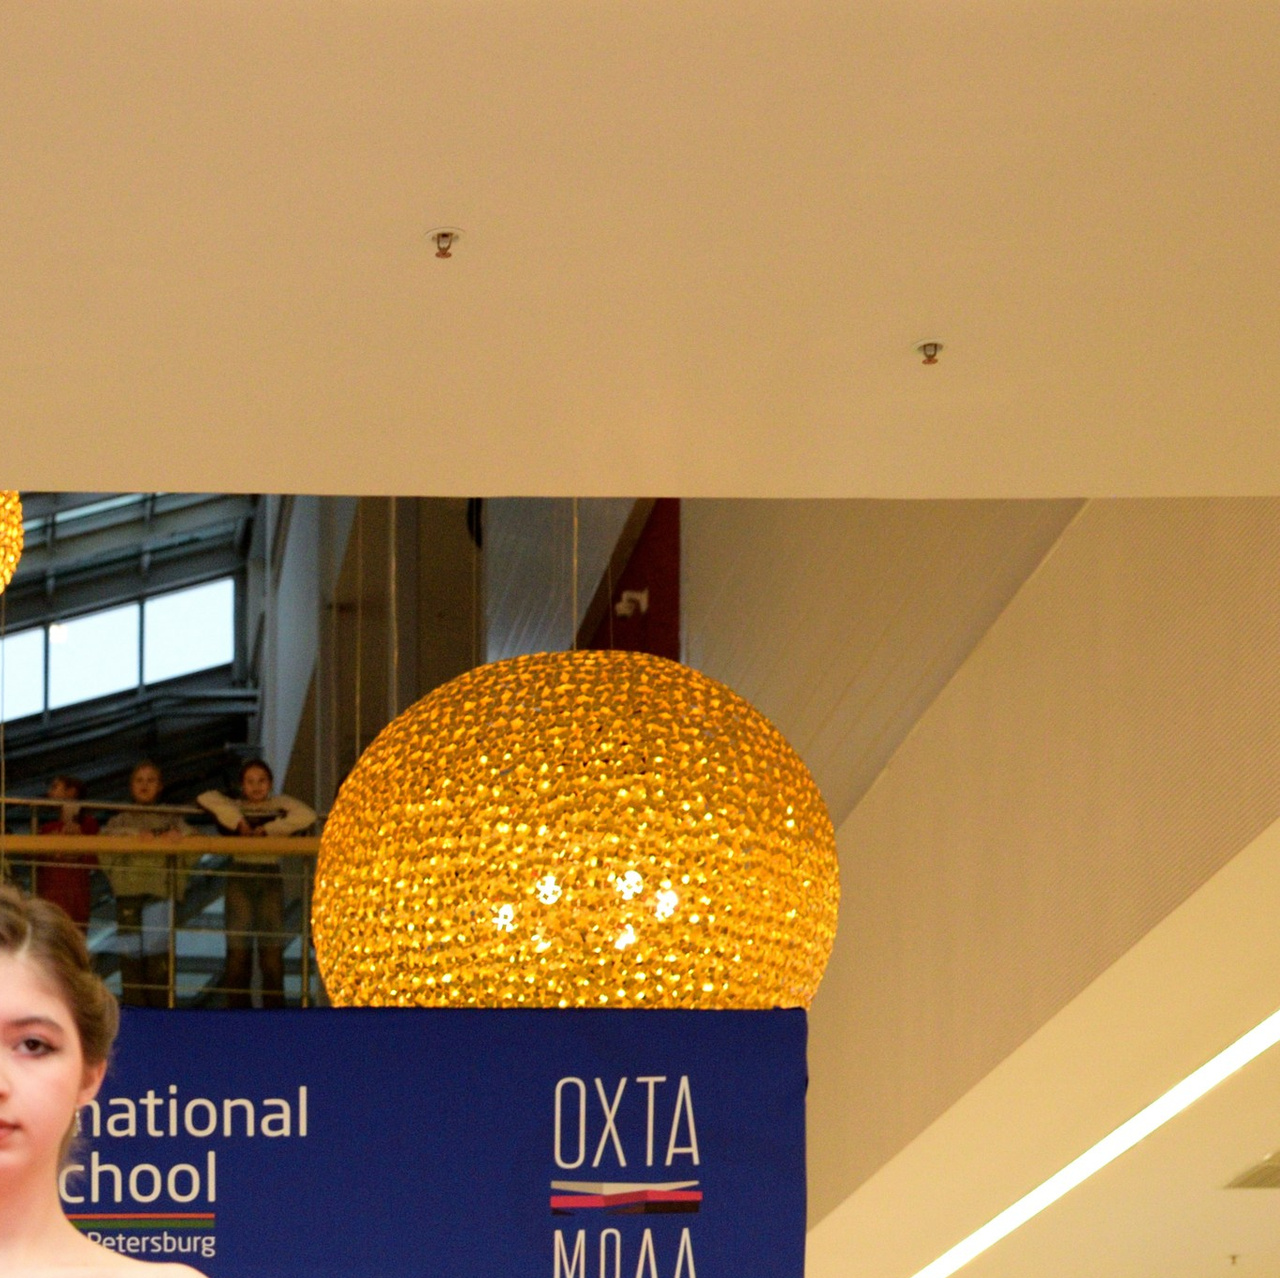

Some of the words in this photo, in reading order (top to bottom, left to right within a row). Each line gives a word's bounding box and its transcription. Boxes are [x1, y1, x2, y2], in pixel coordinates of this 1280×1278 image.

[73, 1084, 308, 1138] national
[554, 1075, 700, 1170] ОХТА
[58, 1150, 216, 1204] chool
